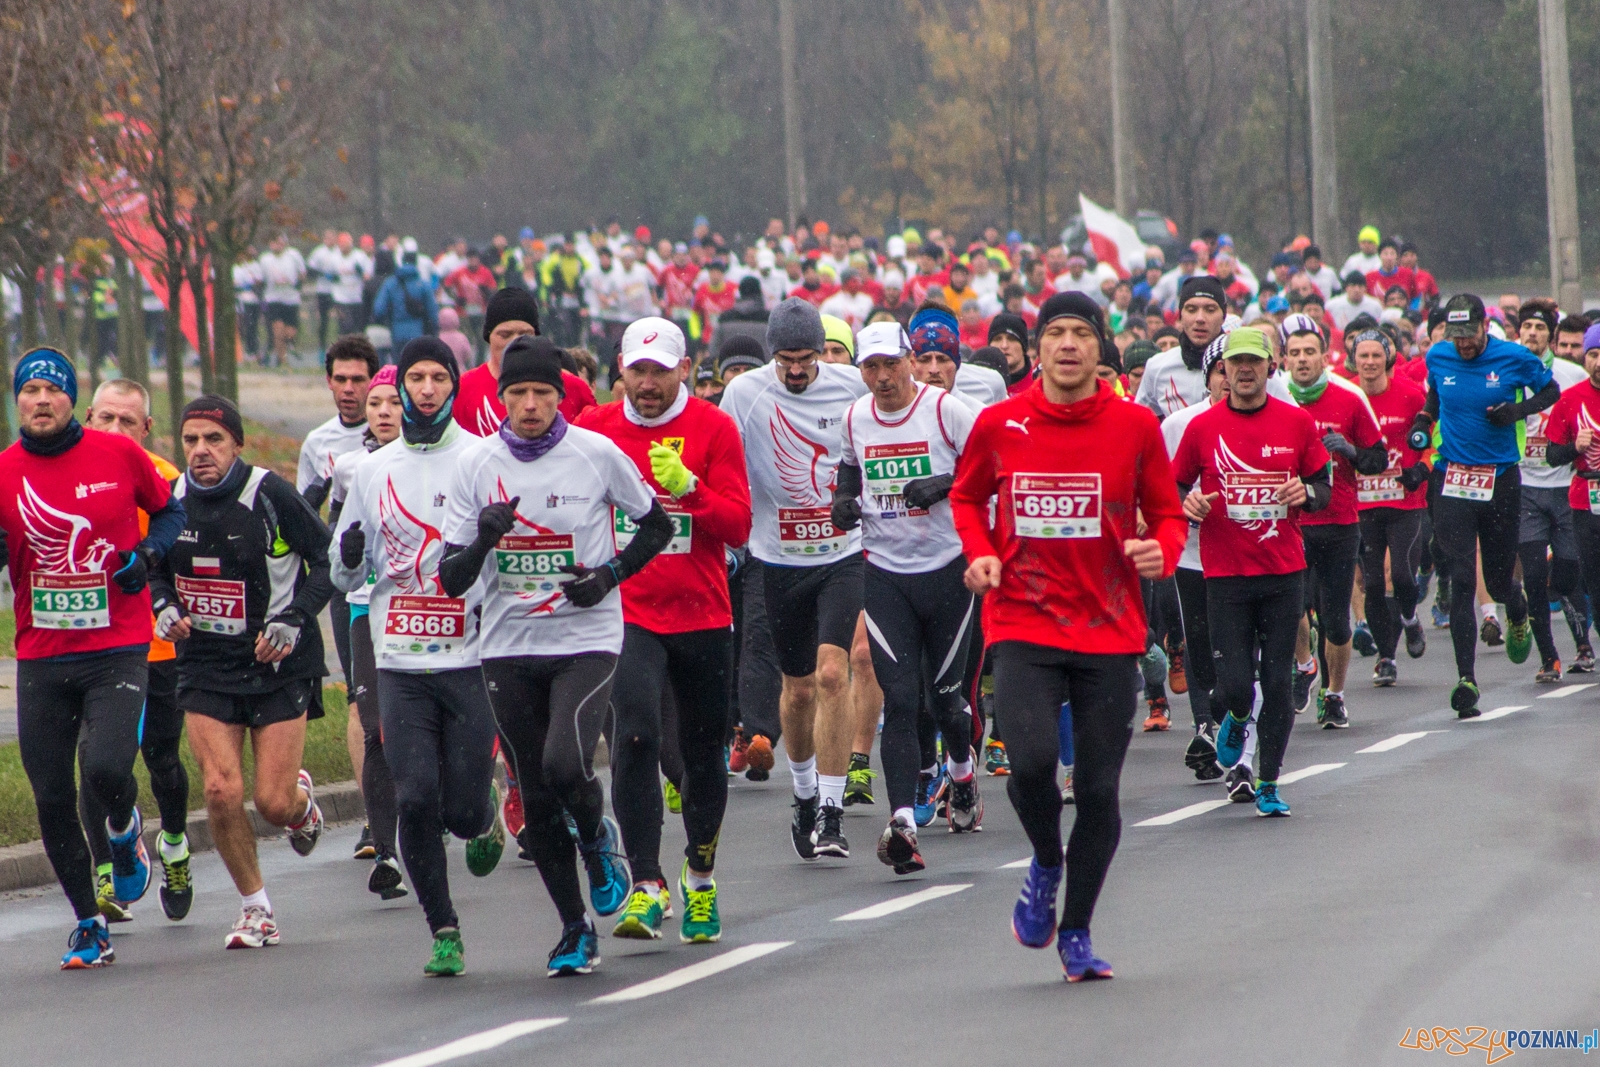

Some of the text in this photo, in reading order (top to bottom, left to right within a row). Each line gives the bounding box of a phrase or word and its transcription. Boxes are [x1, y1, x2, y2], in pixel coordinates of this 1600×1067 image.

[1530, 446, 1547, 457] 29
[874, 458, 922, 478] 1011
[1363, 477, 1398, 491] 8146
[1451, 472, 1490, 488] 8127
[1023, 495, 1091, 517] 6997
[616, 517, 622, 525] C
[794, 521, 834, 540] 996
[505, 553, 567, 573] 2889
[42, 591, 99, 611] 1933
[183, 595, 236, 617] 7557
[427, 602, 461, 610] RunPoland.org
[395, 614, 456, 636] 3668
